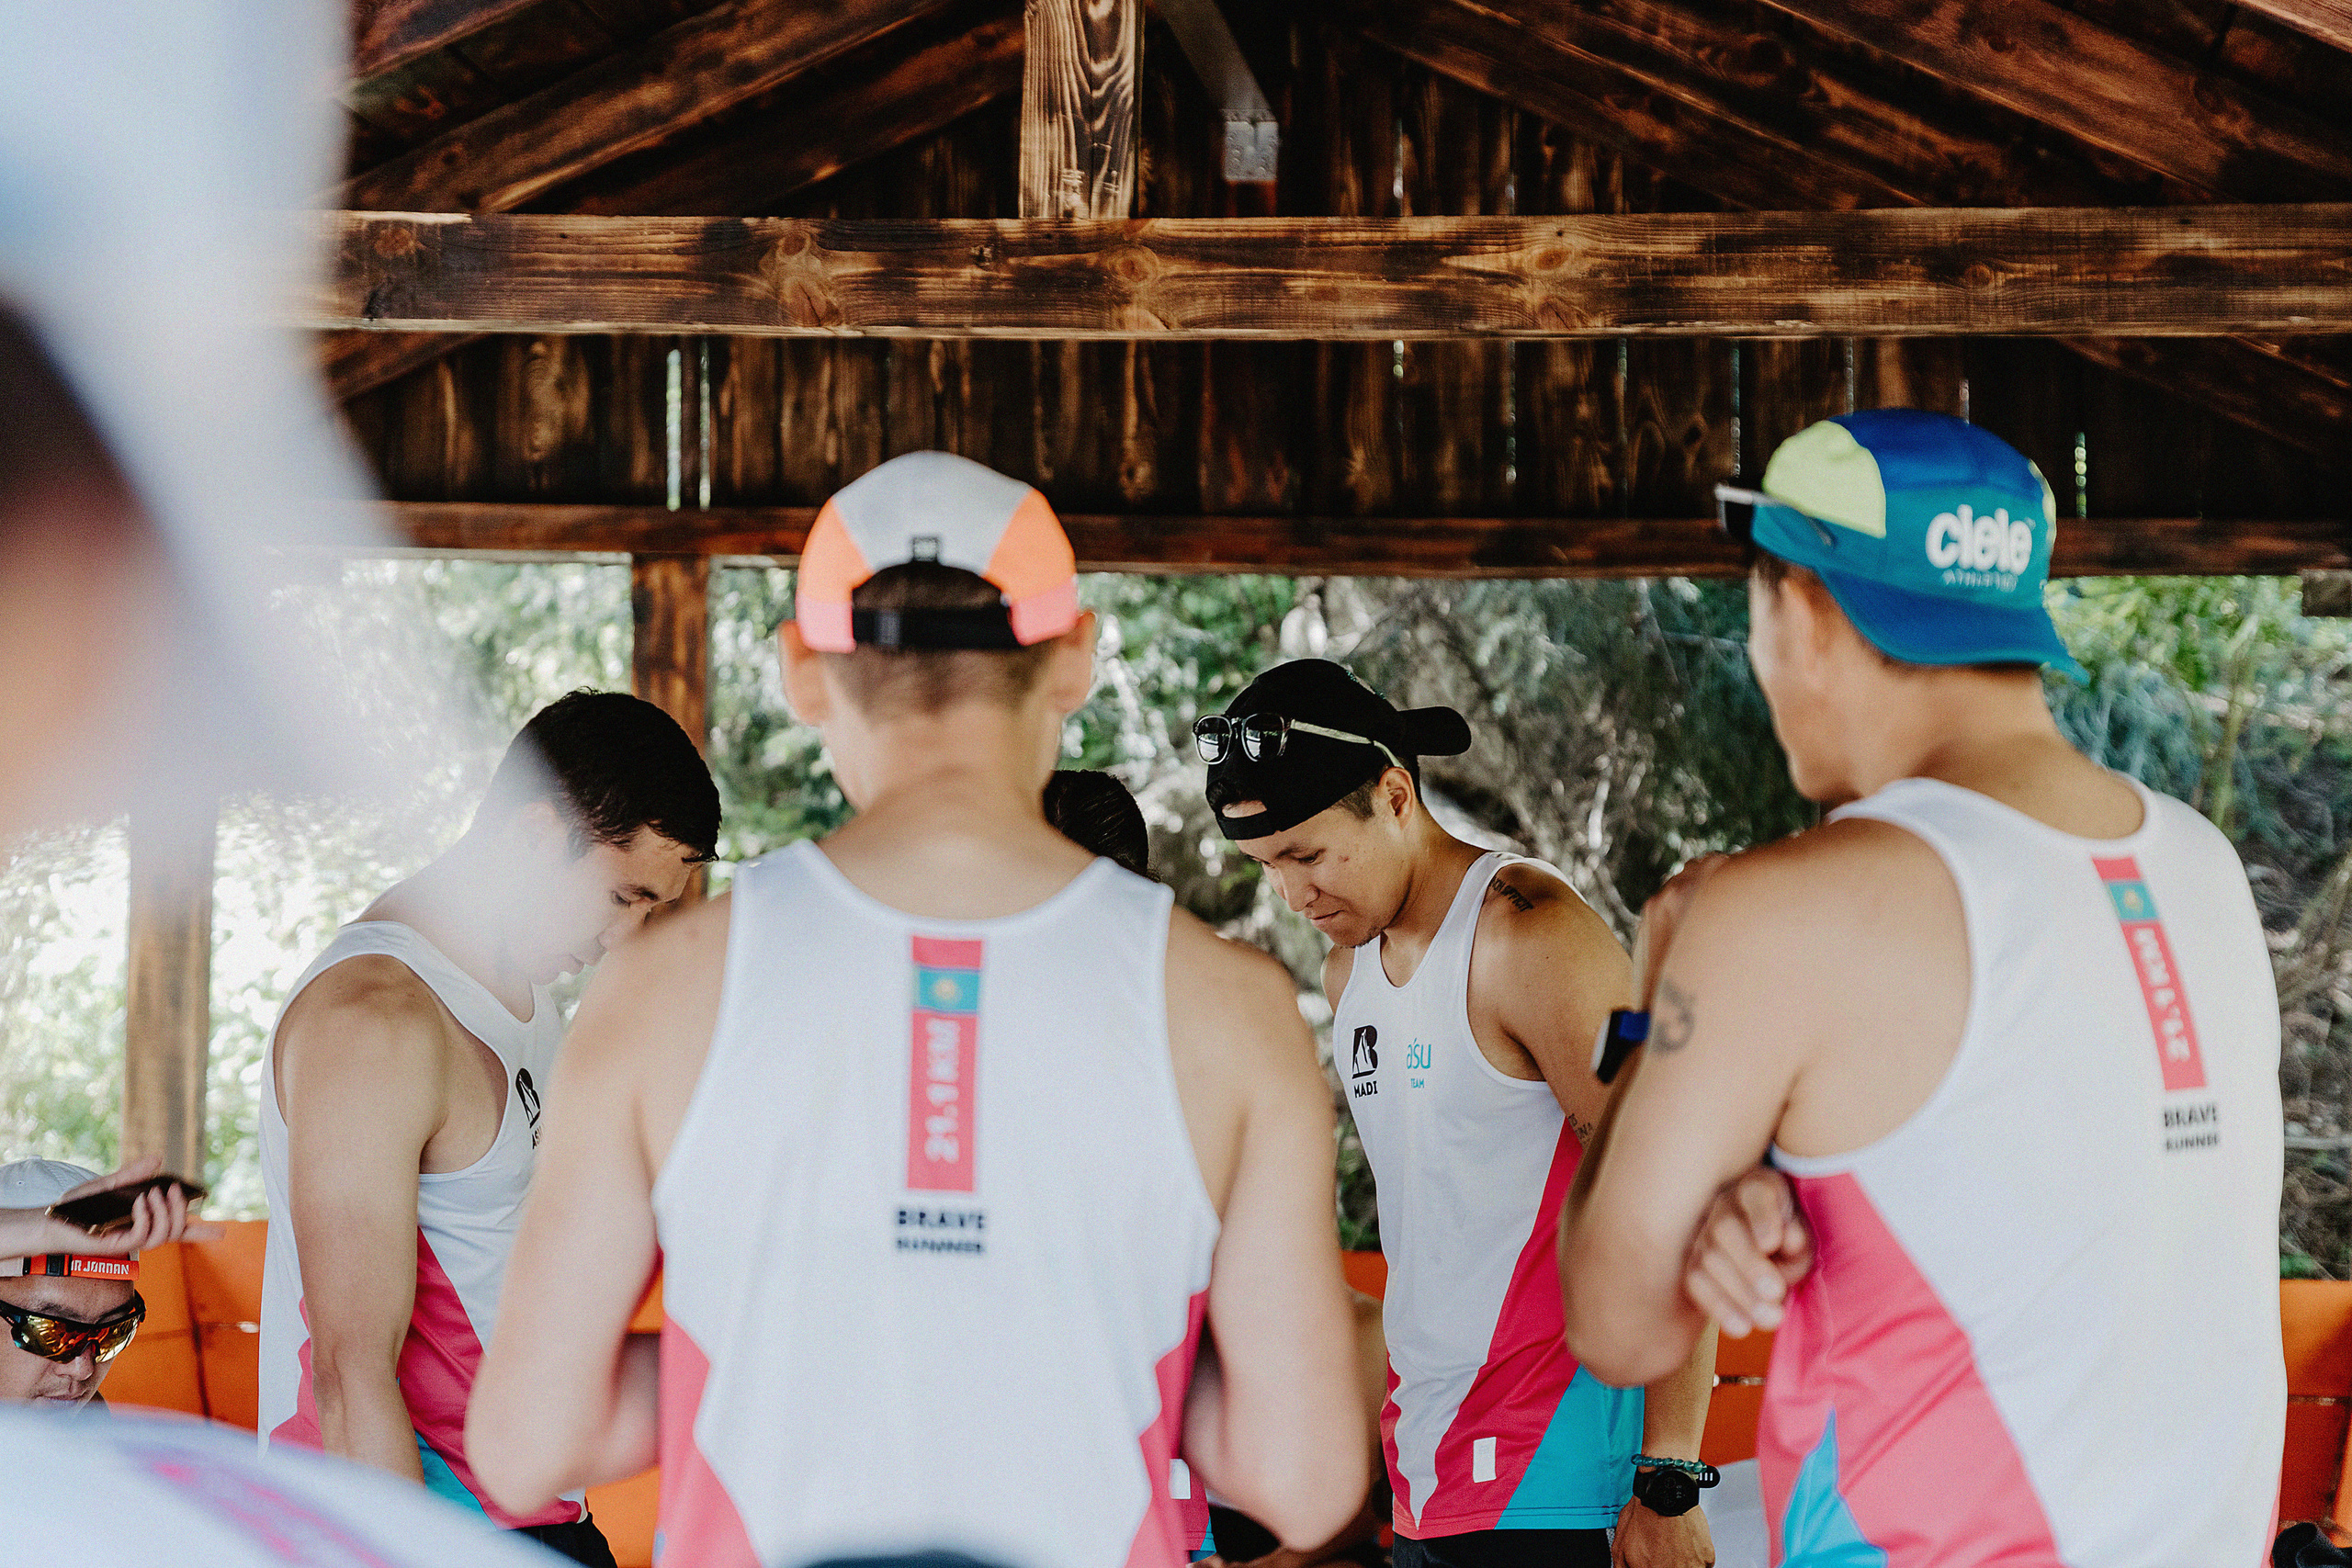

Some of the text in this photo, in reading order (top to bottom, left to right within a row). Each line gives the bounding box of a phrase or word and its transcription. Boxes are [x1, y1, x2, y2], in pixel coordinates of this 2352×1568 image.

[1354, 1080, 1378, 1098] MADI
[1410, 1077, 1425, 1089] TEAM
[71, 1259, 130, 1275] IR JORDAN
